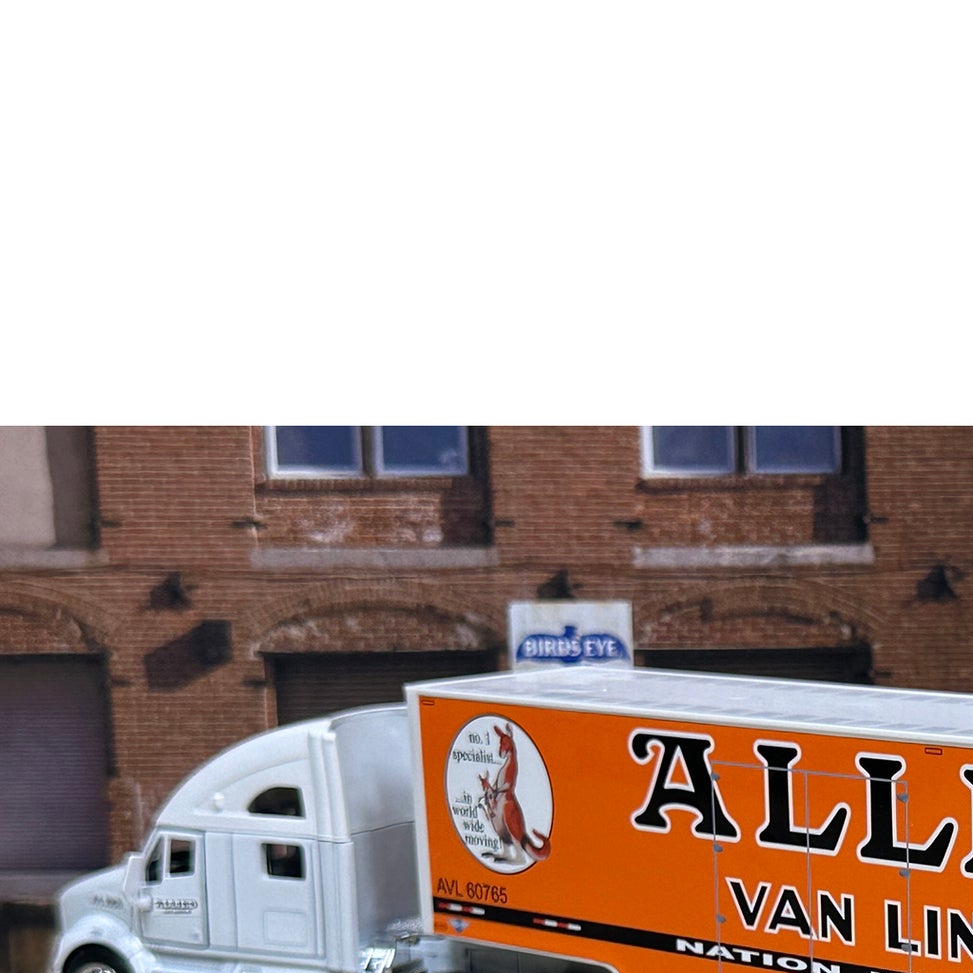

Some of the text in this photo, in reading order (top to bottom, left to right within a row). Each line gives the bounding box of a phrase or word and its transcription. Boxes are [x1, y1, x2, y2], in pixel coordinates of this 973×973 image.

[584, 640, 617, 657] EYE
[453, 805, 478, 819] world
[463, 820, 485, 833] wide
[437, 878, 508, 904] AVL 60765
[725, 877, 855, 946] VAN
